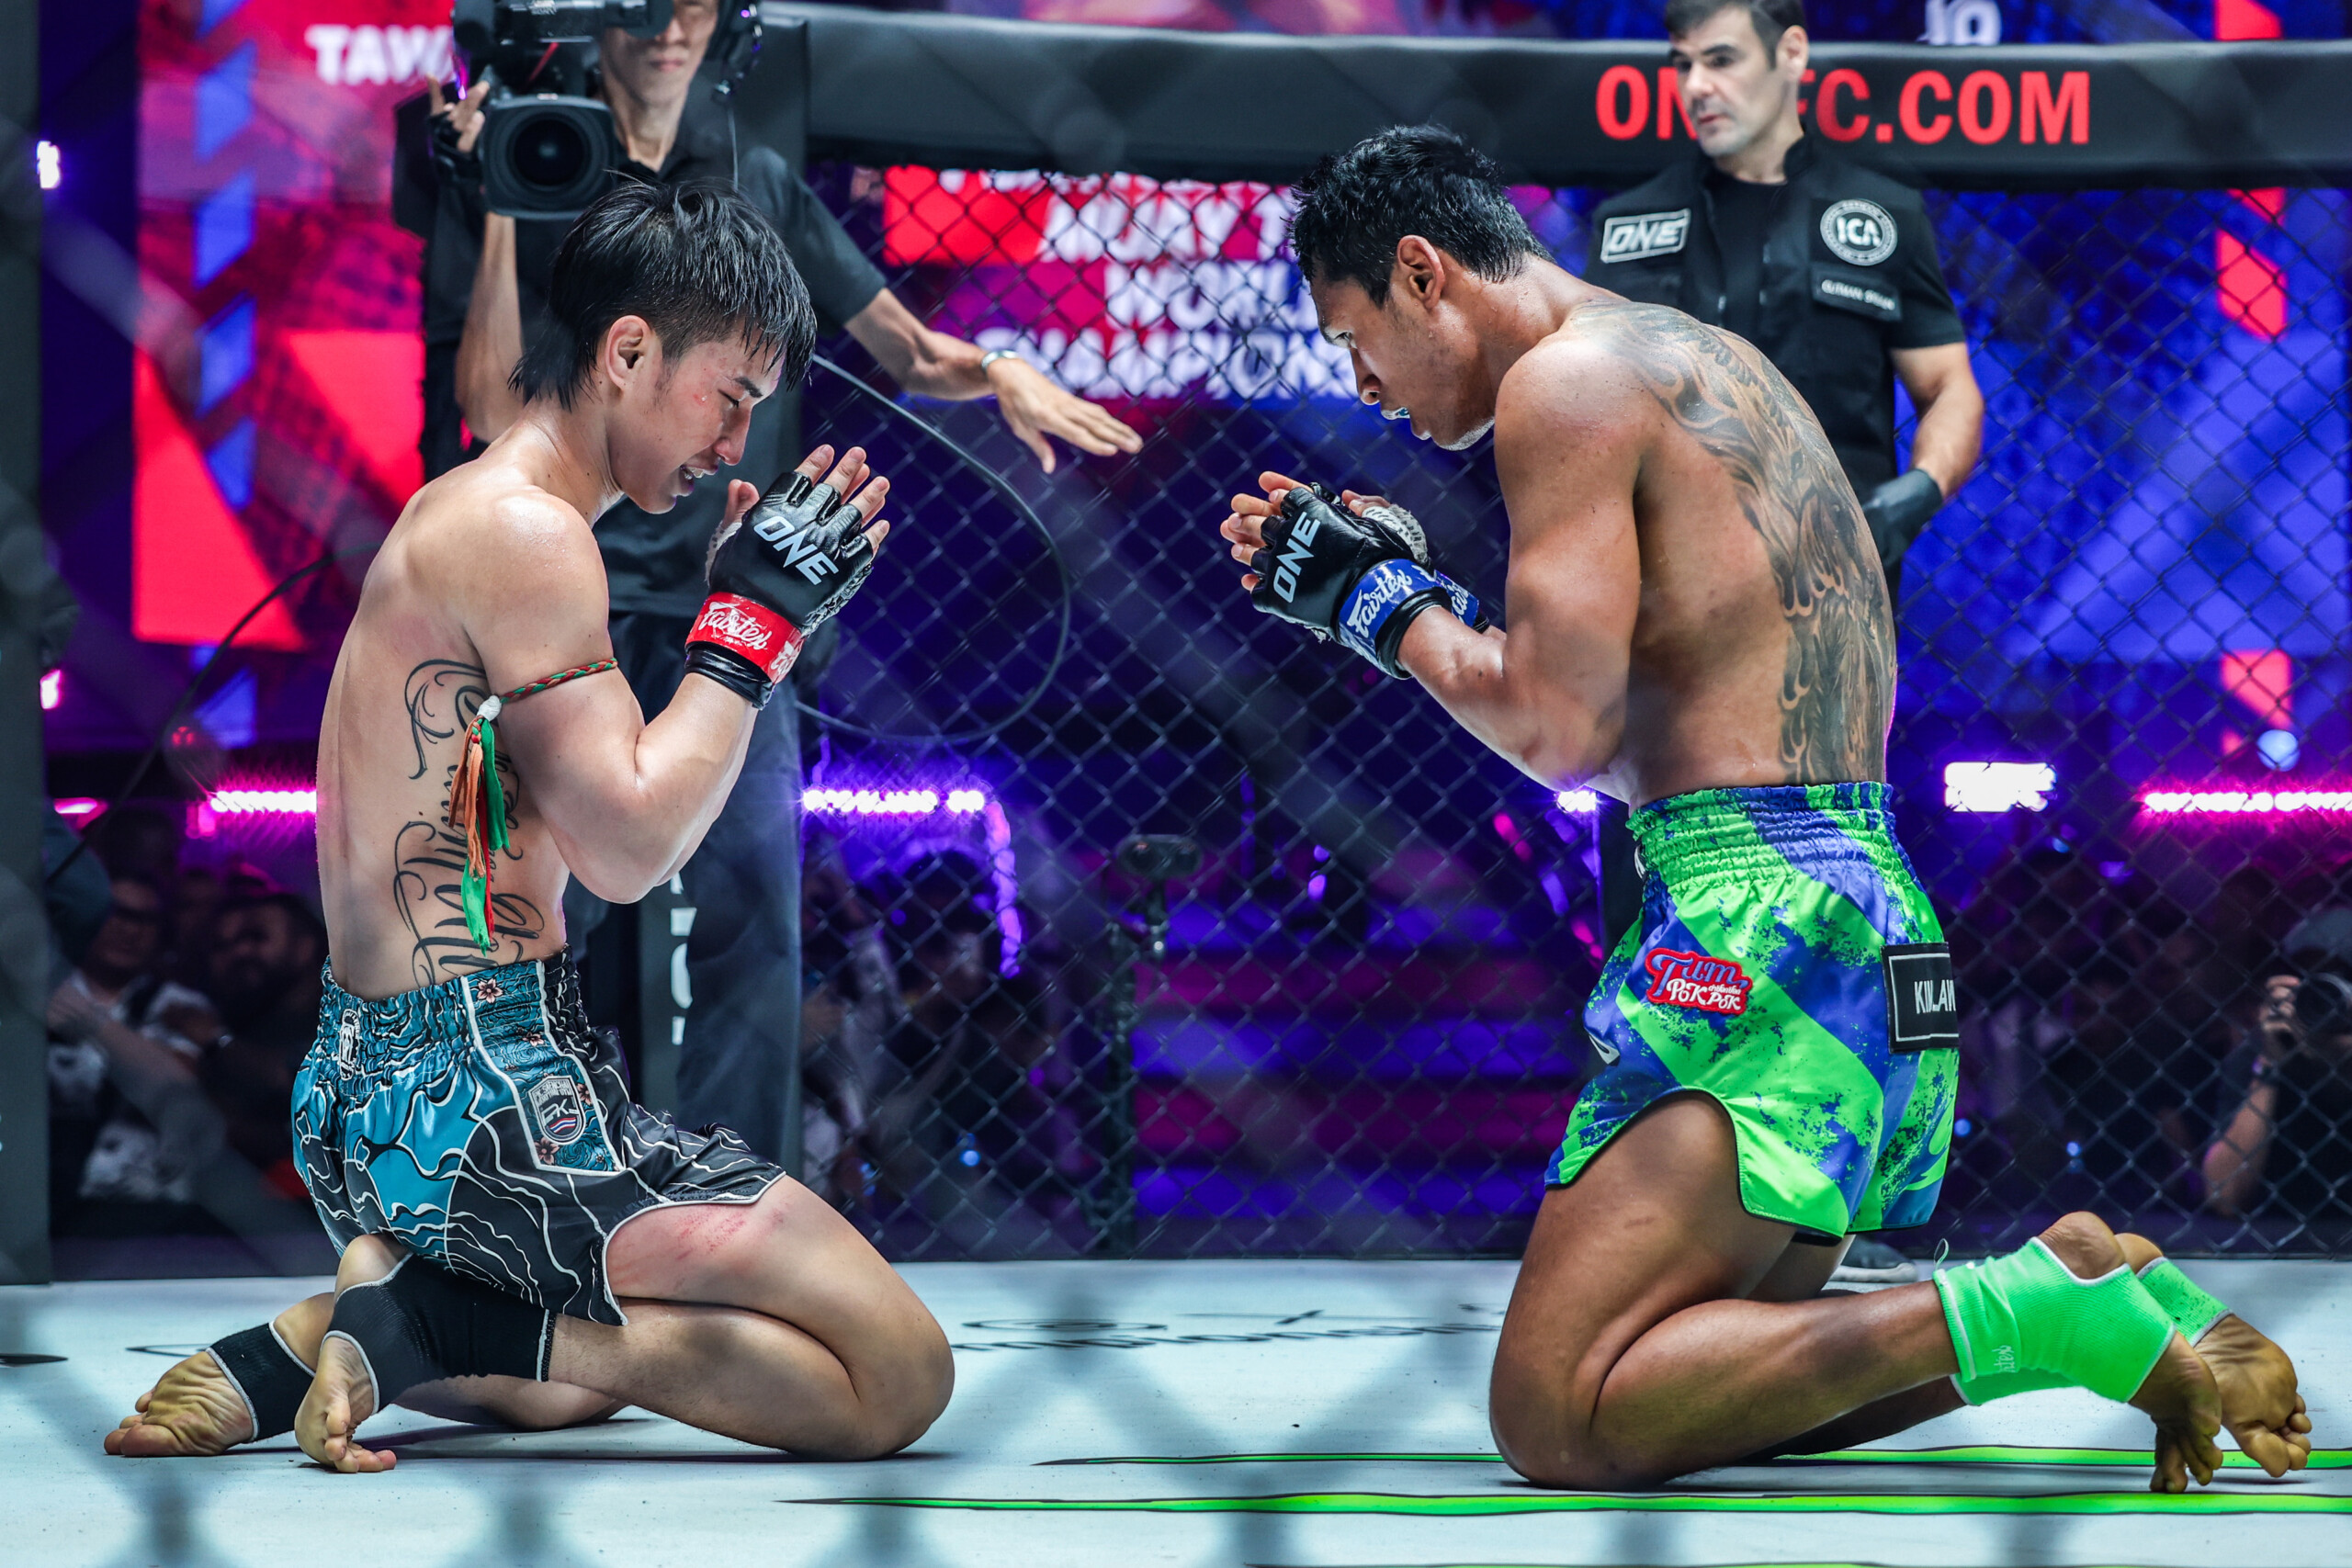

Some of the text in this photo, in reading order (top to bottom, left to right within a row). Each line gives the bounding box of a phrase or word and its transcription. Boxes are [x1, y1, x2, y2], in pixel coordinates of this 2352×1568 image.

[304, 23, 455, 86] TAW
[1596, 64, 2090, 145] ONC.COM
[1608, 218, 1690, 254] ONE
[1836, 216, 1882, 247] ICA
[754, 515, 840, 586] ONE
[1273, 511, 1321, 604] ONE
[1347, 570, 1413, 638] Fairtex
[1651, 953, 1749, 997] Tum
